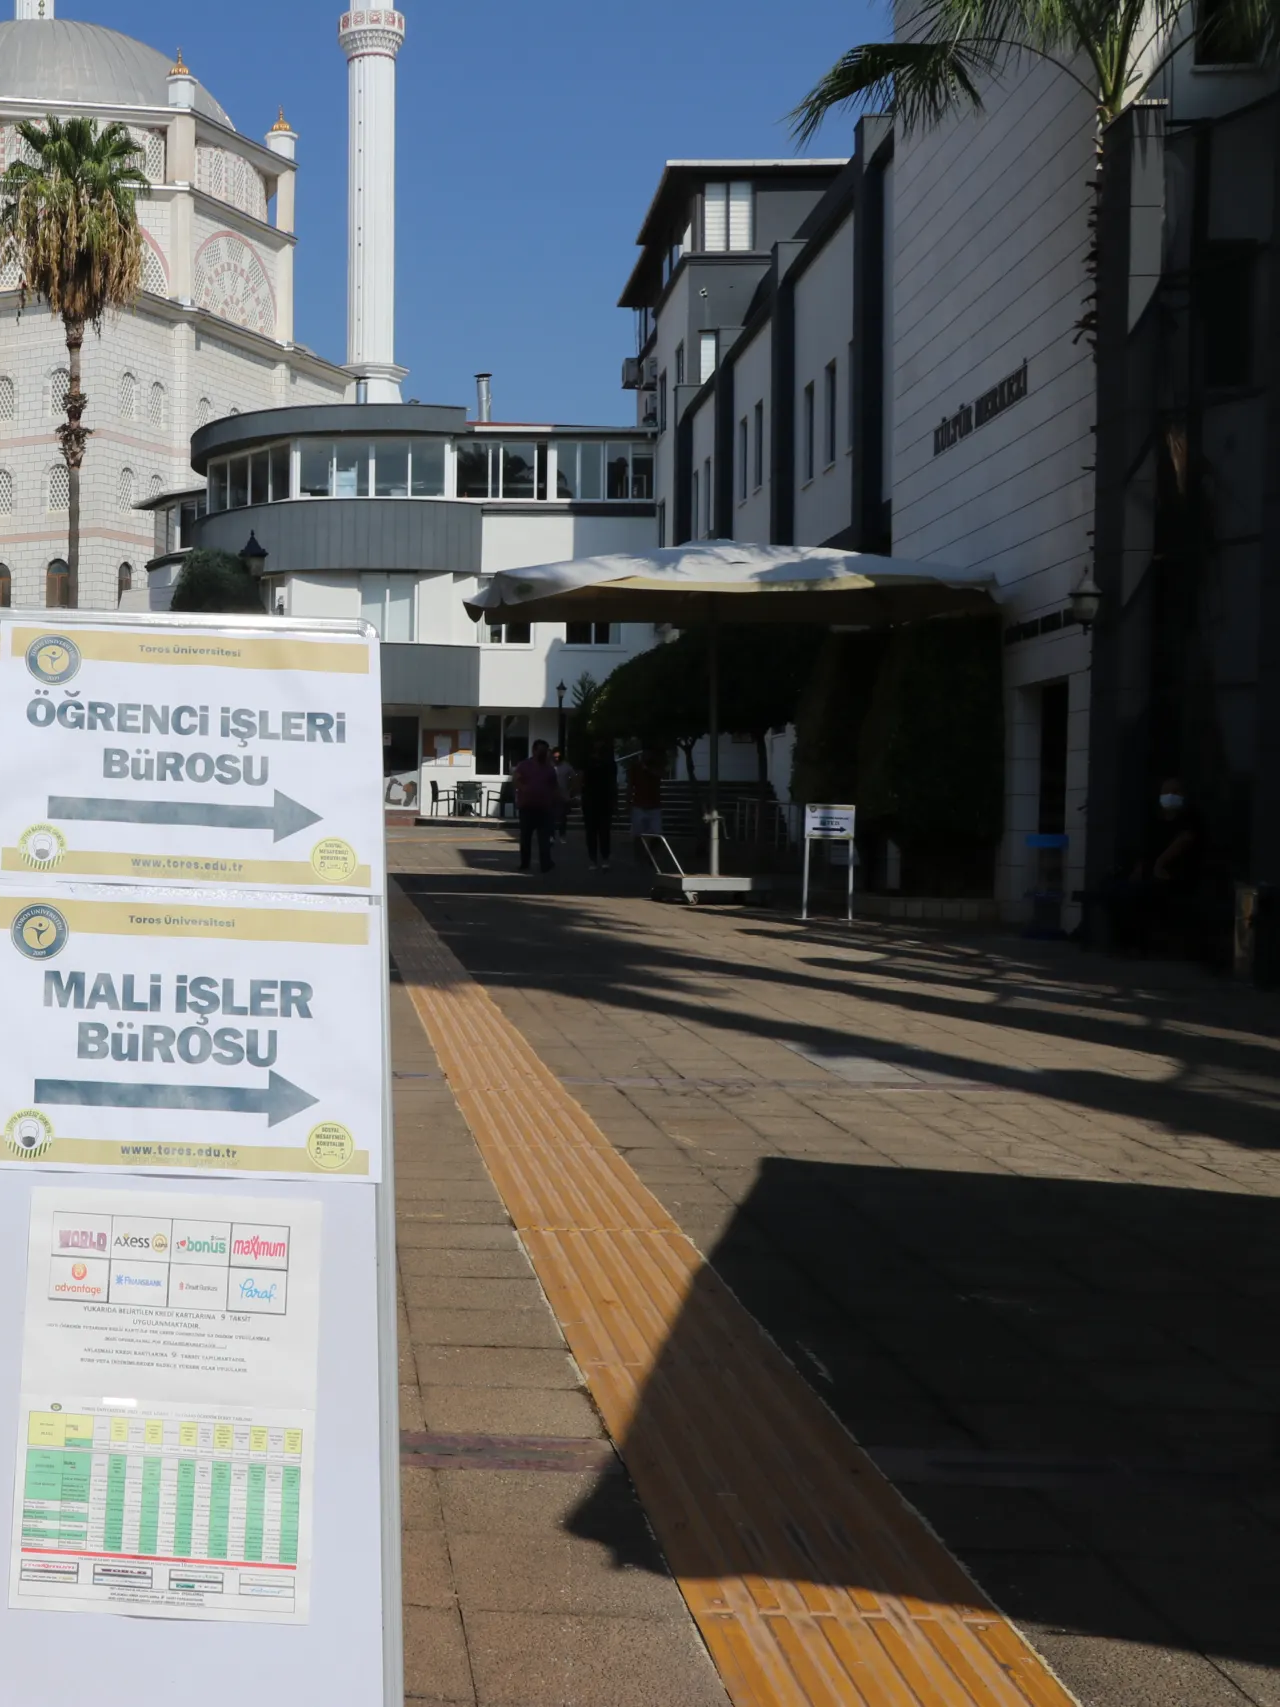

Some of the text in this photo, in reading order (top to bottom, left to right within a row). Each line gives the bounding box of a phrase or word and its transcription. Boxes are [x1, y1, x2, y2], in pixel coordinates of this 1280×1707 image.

[139, 644, 241, 658] Toros Üniversitesi
[131, 858, 243, 872] www.toros.edu.tr
[128, 915, 235, 928] Toros Üniversitesi
[121, 1144, 237, 1158] www.toros.edu.tr
[59, 1230, 108, 1252] WORLD
[114, 1233, 150, 1249] Axess
[187, 1236, 227, 1254] bonus
[55, 1283, 102, 1297] advantage
[83, 1306, 117, 1314] YUKARIDA
